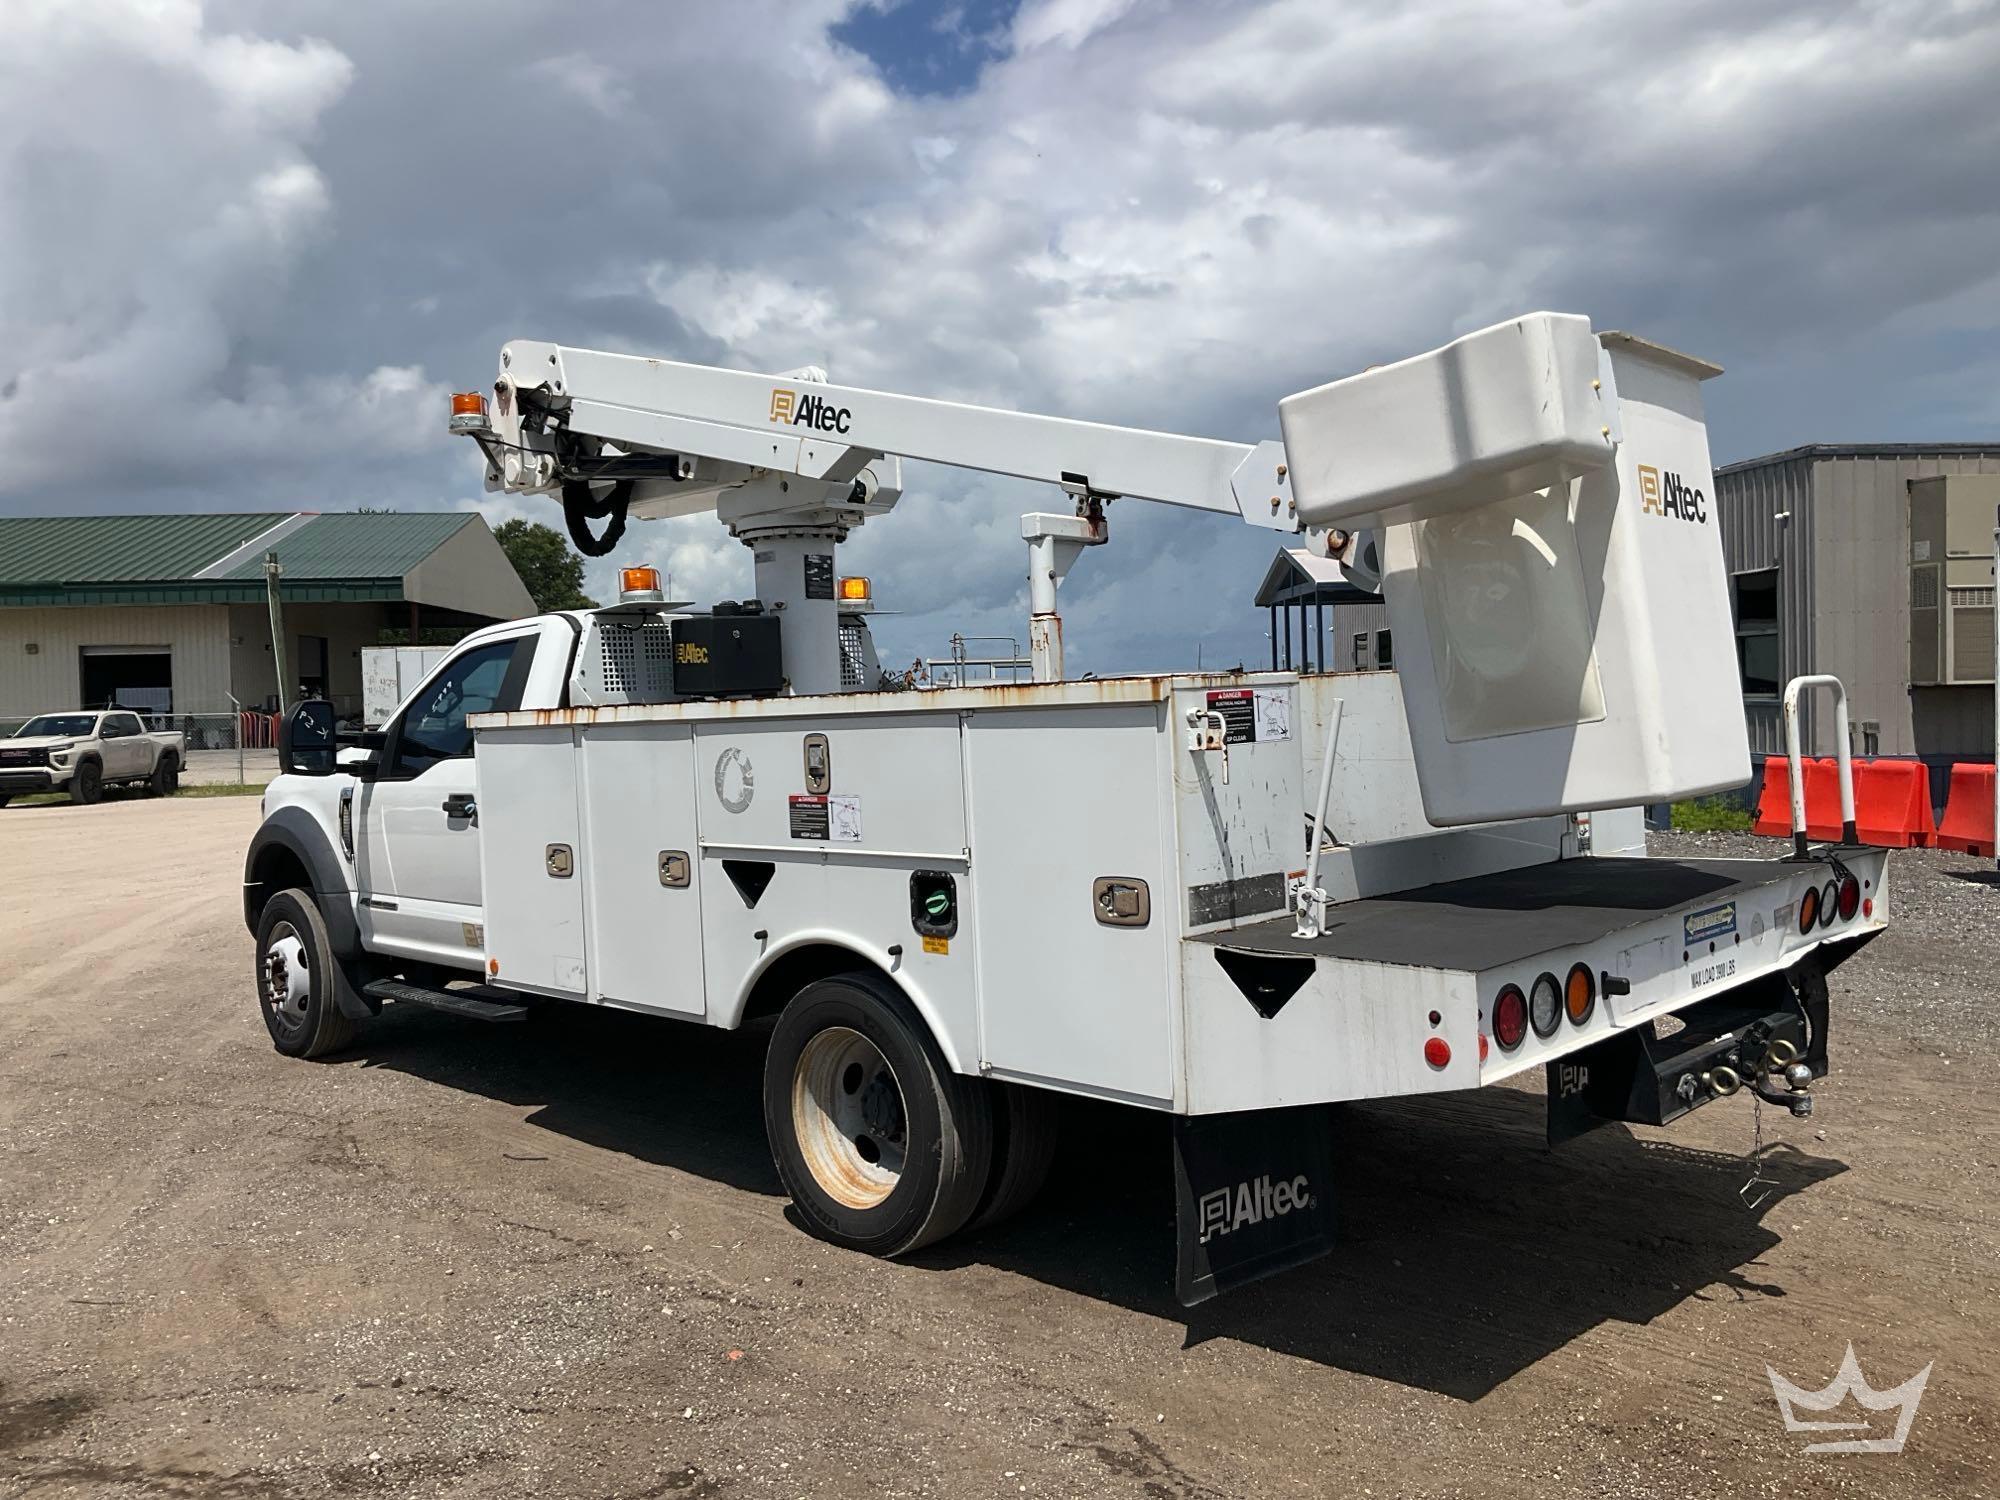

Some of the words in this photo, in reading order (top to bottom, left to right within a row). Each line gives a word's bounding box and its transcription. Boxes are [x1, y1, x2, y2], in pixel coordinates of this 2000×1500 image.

[793, 394, 851, 434] Altec
[1663, 471, 1707, 524] Altec
[686, 643, 708, 664] Altec
[1223, 691, 1242, 699] DANGER
[1691, 971, 1702, 989] MAX
[1702, 966, 1715, 985] LOAD
[1726, 959, 1736, 977] LBS
[1232, 1174, 1310, 1231] Altec
